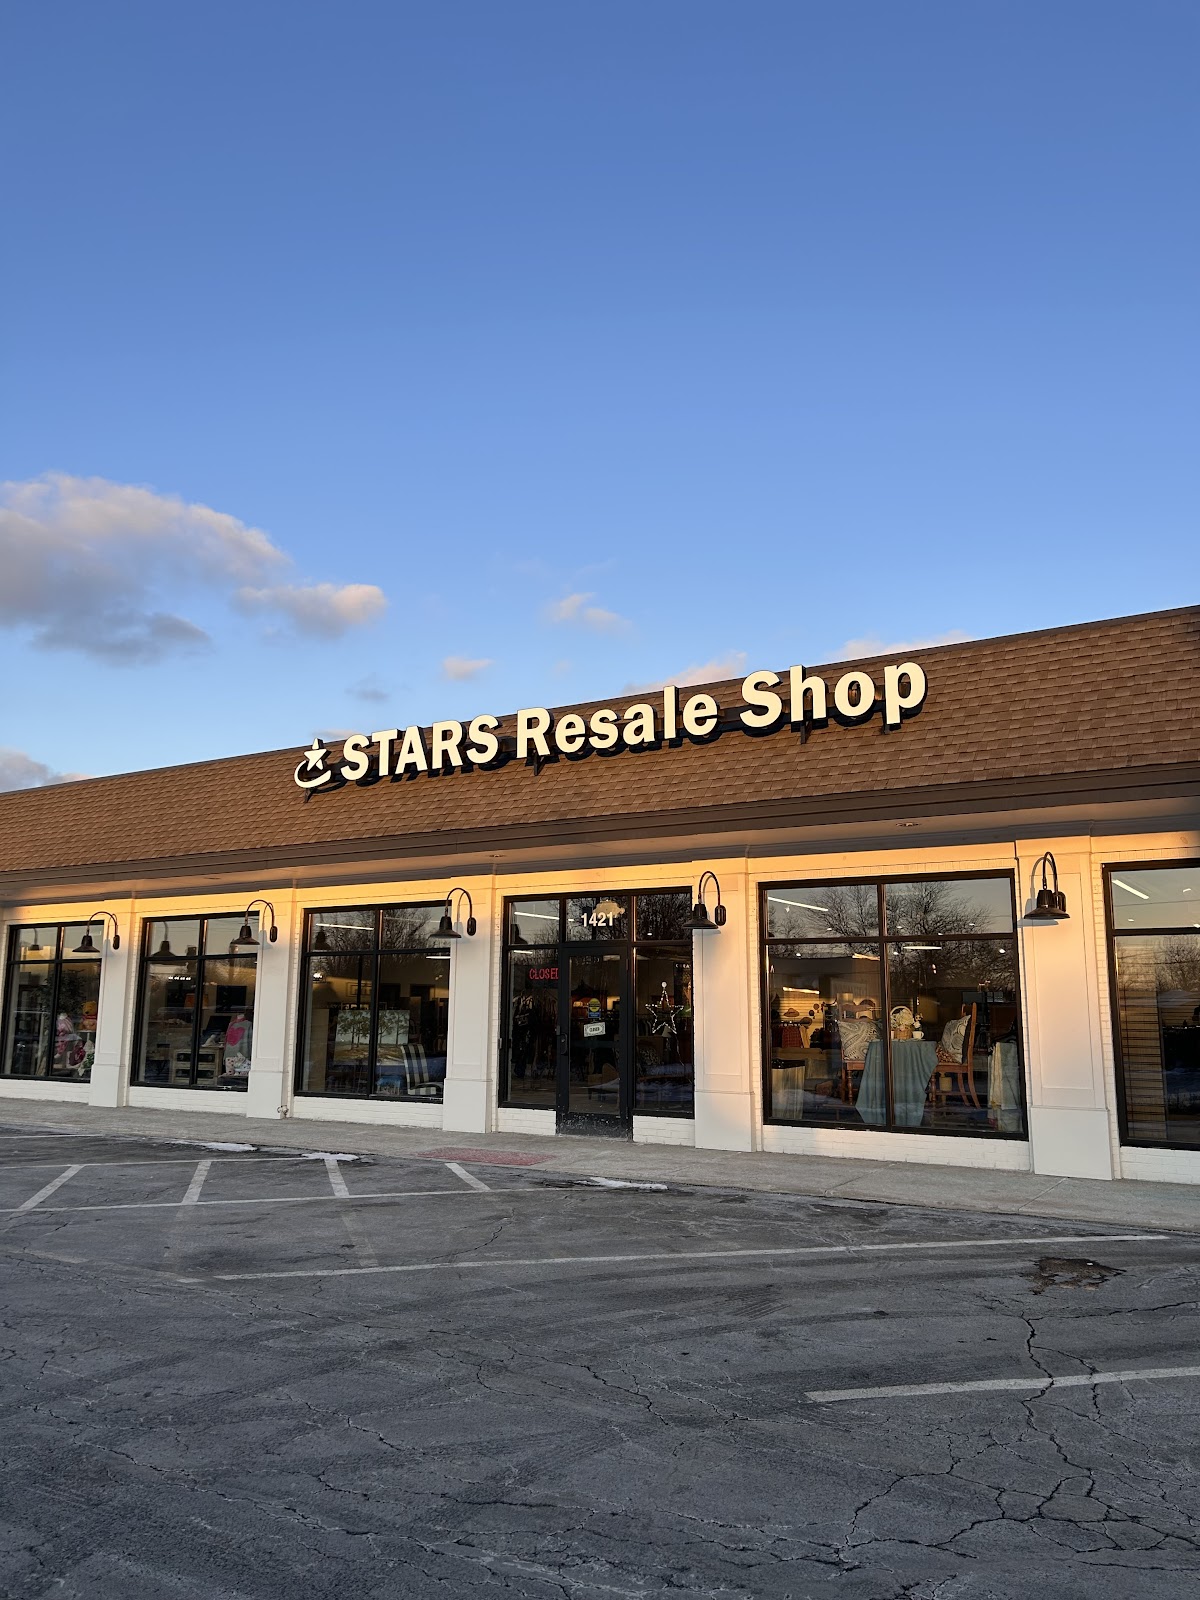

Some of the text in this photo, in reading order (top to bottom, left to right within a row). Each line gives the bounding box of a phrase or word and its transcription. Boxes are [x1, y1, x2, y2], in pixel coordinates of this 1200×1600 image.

[340, 661, 928, 782] STARS Resale Shop
[581, 911, 614, 927] 1421
